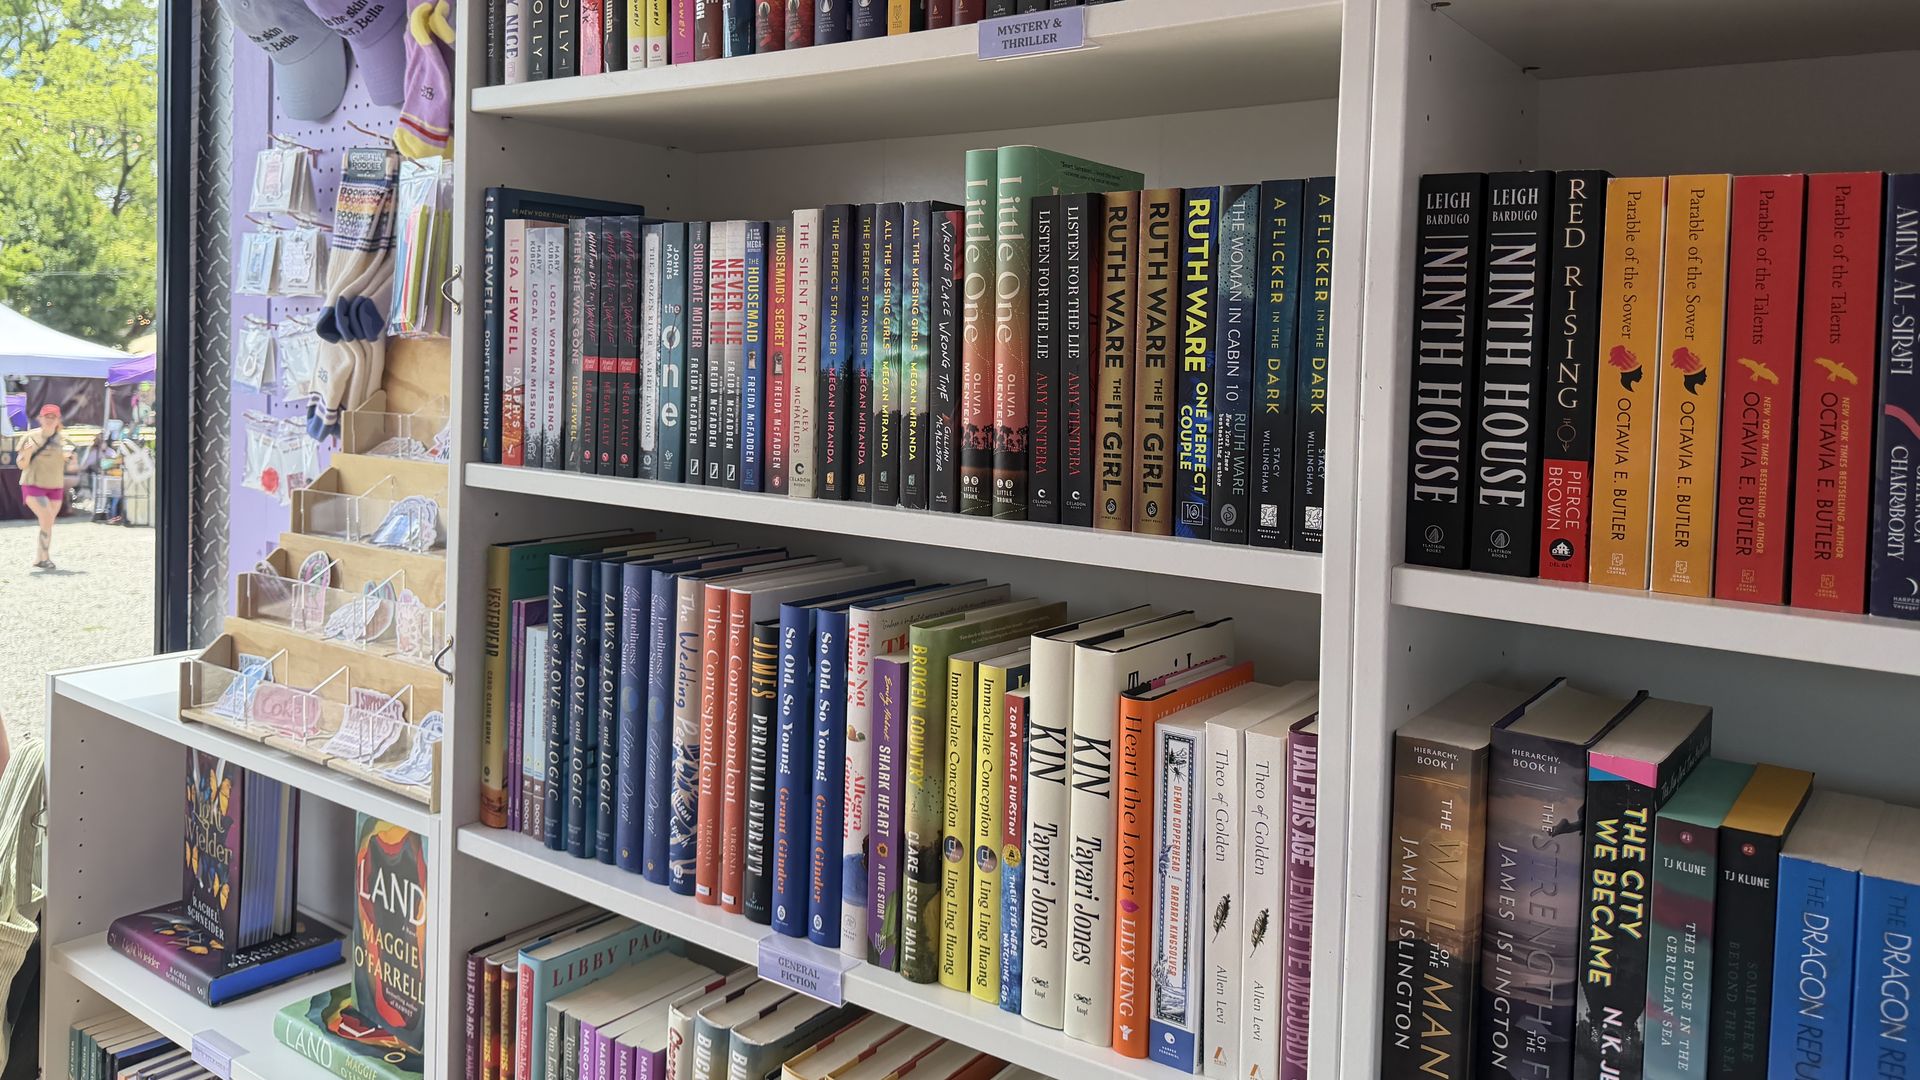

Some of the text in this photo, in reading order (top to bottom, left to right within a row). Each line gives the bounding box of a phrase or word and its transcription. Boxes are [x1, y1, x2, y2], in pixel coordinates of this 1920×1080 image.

[271, 34, 299, 52] Bella
[357, 3, 385, 31] Bella
[998, 18, 1063, 36] MYSTERY &
[1002, 33, 1057, 50] THRILLER
[1492, 188, 1539, 207] LEIGH
[1492, 210, 1538, 223] BARDUGO
[508, 239, 519, 355] LISA JEWELL
[692, 243, 704, 348] SURROGATE MOTHER
[774, 234, 786, 348] HOUSEMAID'S SECRET
[912, 243, 920, 265] THE
[912, 268, 920, 315] MISSING
[996, 176, 1024, 344] Little One
[1068, 206, 1080, 359] LISTEN FOR THE LIE
[1105, 206, 1128, 369] RUTH WARE
[1184, 198, 1211, 372] RUTH WARE
[1557, 178, 1587, 409] RED RISING
[1621, 190, 1642, 340] Parable of the Sower
[726, 258, 744, 345] NEVER LIE
[746, 266, 760, 343] HOUSEMAID
[798, 224, 809, 374] THE SILENT PATIENT
[910, 318, 920, 351] GIRLS
[936, 220, 953, 402] WRONG PLACE WRONG TIME
[1226, 200, 1246, 402] THE WOMAN IN CABIN 10
[1266, 198, 1287, 415] A FLICKER IN THE DARK
[530, 327, 538, 374] WOMAN
[1112, 378, 1122, 401] THE
[1479, 242, 1537, 508] NINTH HOUSE
[503, 376, 513, 420] PARTY
[512, 367, 521, 428] RALPH'S
[996, 362, 1004, 428] MUENTER
[1007, 374, 1016, 418] OLIVIA
[1068, 372, 1081, 476] AMY TINTERA
[1180, 405, 1193, 471] COUPLE
[1102, 404, 1123, 491] IT GIRL
[1194, 382, 1209, 496] ONE PERFECT
[1232, 413, 1246, 496] RUTH WARE
[1261, 430, 1271, 494] WILLINGHAM
[1273, 448, 1281, 478] STACY
[1611, 398, 1632, 541] OCTAVIA E. BUTLER
[1546, 466, 1563, 531] BROWN
[1565, 470, 1582, 529] PIERCE
[1888, 446, 1909, 561] CHAKRABORTY
[752, 636, 778, 699] JAMES
[820, 631, 833, 655] So
[572, 589, 588, 809] LAWS of LOVE and LOGIC
[701, 604, 723, 796] The Correspondent
[818, 698, 831, 722] So
[908, 644, 928, 791] BROKEN COUNTRY
[876, 745, 892, 838] SHARK HEART
[948, 671, 963, 828] Immaculate Conception
[1072, 732, 1112, 800] KIN
[1414, 746, 1459, 761] HIERARCHY,
[1417, 756, 1448, 770] BOOK
[748, 714, 768, 877] PERCIVAL EVERETT
[1122, 714, 1142, 896] Heart the Lover
[1171, 785, 1183, 873] DEMON COPPERHEAD
[1214, 749, 1230, 863] Theo of Golden
[1290, 744, 1318, 868] HALF HIS AGE
[192, 896, 220, 924] RACHEL
[359, 859, 427, 926] LAND
[904, 830, 920, 962] CLARE LESLIE HALL
[1070, 836, 1102, 966] Tayari Jones
[1586, 818, 1619, 988] WE BECAME
[1618, 806, 1648, 940] THE CITY
[1664, 857, 1707, 876] TJ KLUNE
[187, 905, 225, 942] SCHNEIDER
[362, 920, 419, 970] MAGGIE
[944, 870, 959, 976] Ling Ling Huang
[1168, 884, 1180, 978] BARBARA KINGSOLVER
[1394, 836, 1420, 1050] JAMES ISLINGTON
[1798, 912, 1830, 1021] DRAGON
[354, 946, 425, 1005] O'FARRELL
[552, 946, 617, 989] LIBBY
[777, 956, 820, 979] GENERAL
[780, 969, 818, 992] FICTION
[1118, 916, 1137, 1018] LILY KING
[1216, 964, 1226, 1025] Allen Levi
